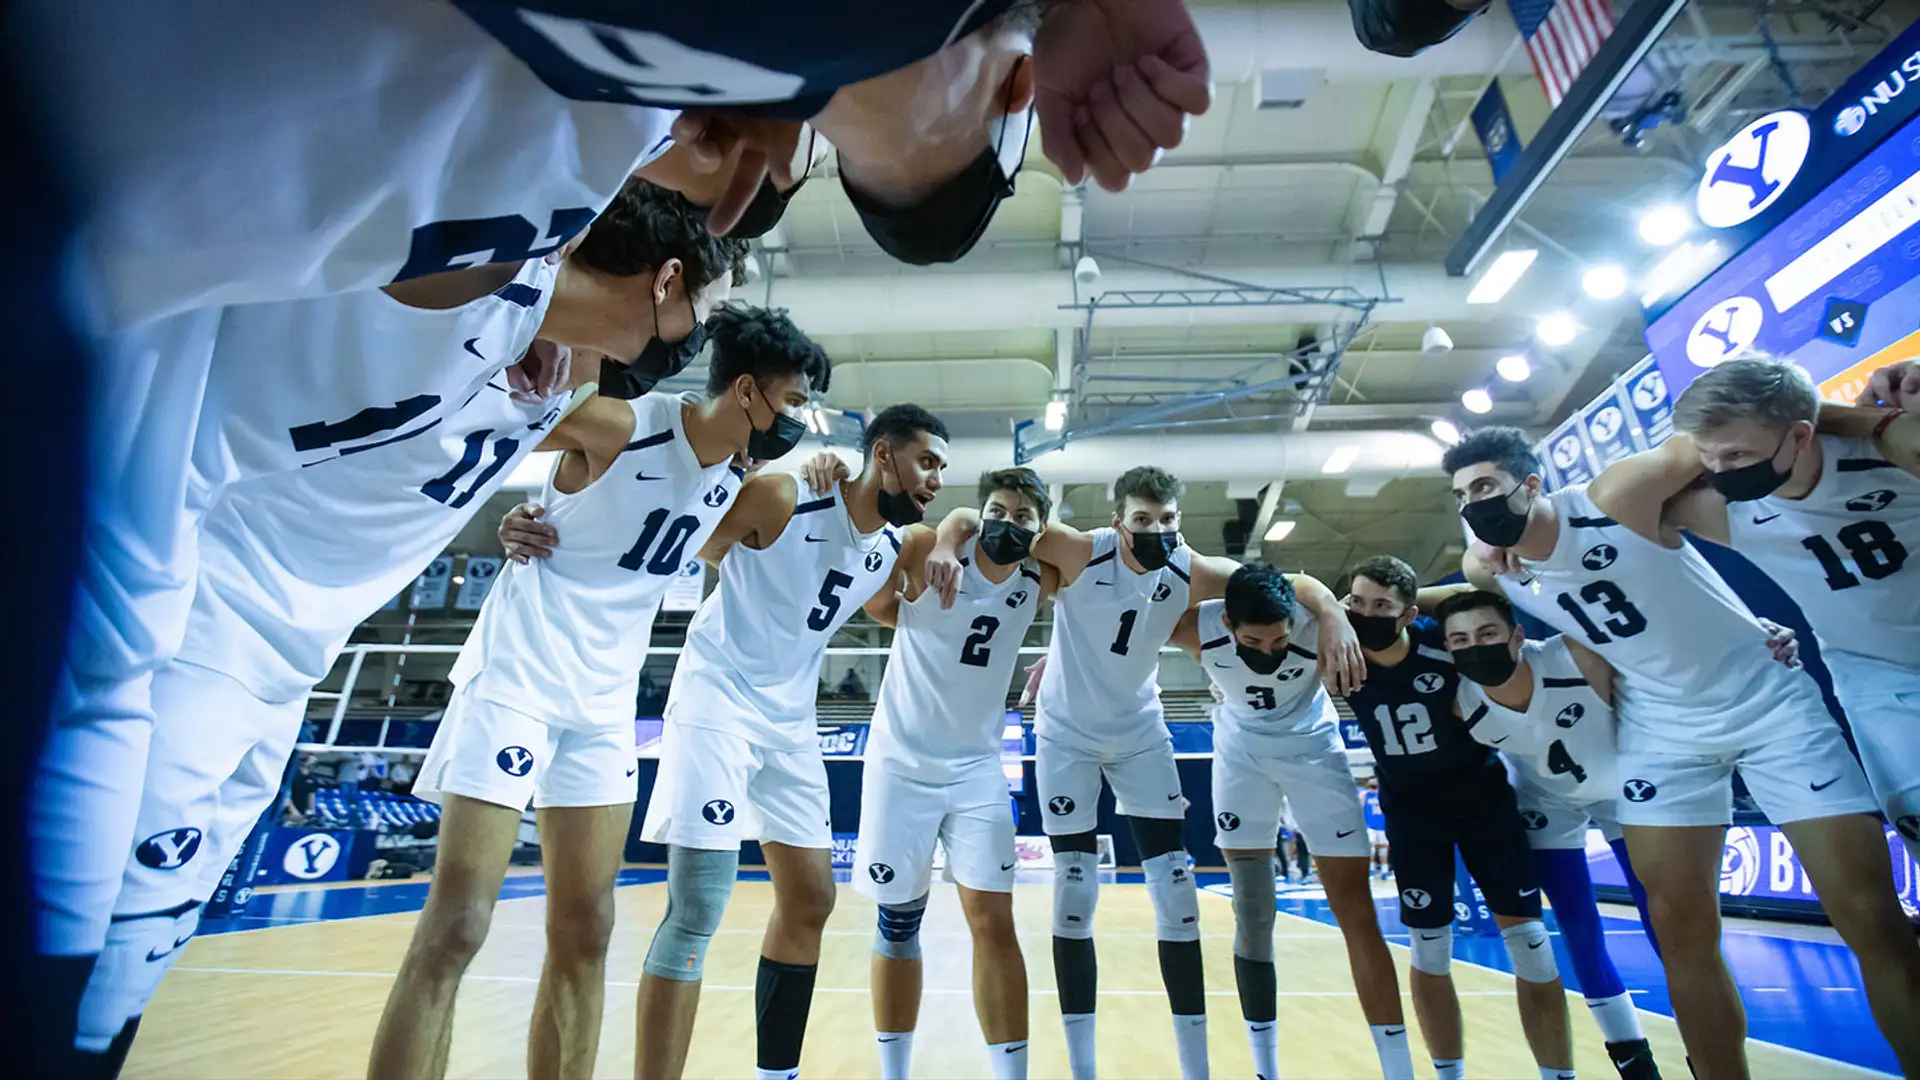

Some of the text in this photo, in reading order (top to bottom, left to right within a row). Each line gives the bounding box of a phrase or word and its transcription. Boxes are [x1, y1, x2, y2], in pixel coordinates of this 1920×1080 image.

[1709, 121, 1780, 209] Y
[1699, 306, 1739, 355] Y
[1829, 311, 1855, 334] VS
[420, 429, 519, 509] 11
[707, 486, 725, 505] Y
[617, 507, 701, 576] 10
[1801, 520, 1908, 591] 18
[867, 553, 881, 570] Y
[807, 569, 854, 632] 5
[1009, 591, 1026, 607] Y
[1557, 580, 1648, 644] 13
[960, 616, 1000, 667] 2
[1110, 609, 1138, 656] 1
[1246, 685, 1276, 711] 3
[1413, 675, 1437, 691] Y
[1374, 702, 1439, 756] 12
[504, 749, 532, 775] Y
[1547, 739, 1587, 783] 4
[1624, 781, 1650, 800] Y
[705, 802, 733, 823] Y
[1051, 799, 1070, 813] Y
[1219, 813, 1236, 829] Y
[150, 830, 198, 868] Y
[300, 839, 332, 873] Y
[871, 864, 890, 882] Y
[1404, 891, 1425, 908] Y
